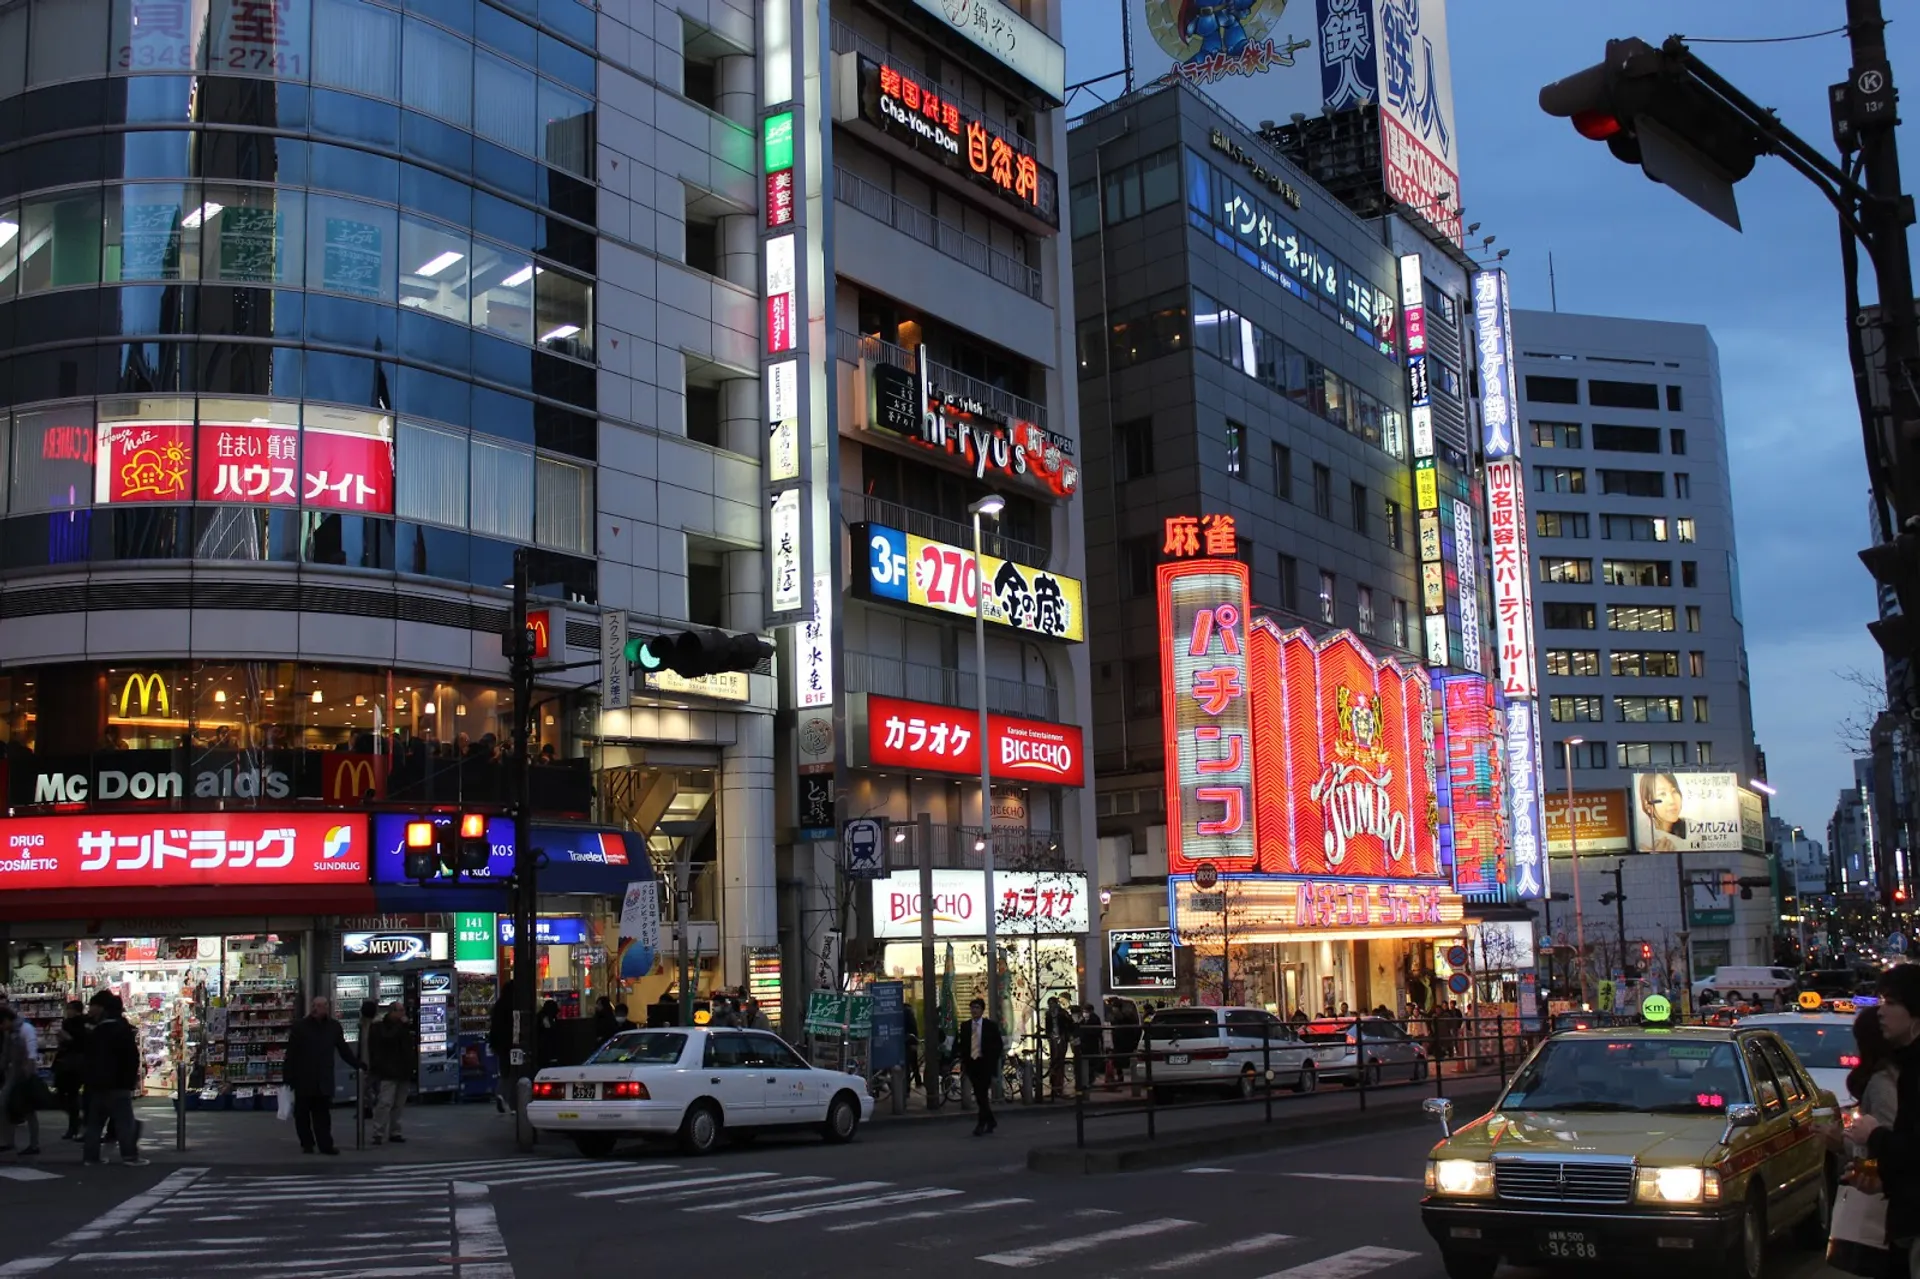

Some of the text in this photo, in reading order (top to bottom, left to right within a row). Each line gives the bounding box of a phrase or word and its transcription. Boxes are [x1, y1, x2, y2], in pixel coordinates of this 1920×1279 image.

[973, 2, 1016, 51] 鍋ぞう
[880, 64, 960, 135] 韓国料理
[880, 94, 959, 155] Cha-Yon-Don
[966, 120, 1039, 207] 自然洞
[776, 173, 792, 224] 美容室
[1225, 196, 1324, 285] インターネット
[1325, 265, 1336, 295] &
[1475, 272, 1510, 454] カラオケの鉄人
[99, 429, 132, 447] House
[123, 430, 158, 455] Mate
[217, 432, 296, 460] 住まい 賃貸
[1417, 459, 1432, 469] 4F
[213, 464, 376, 505] ハウスメイト
[1163, 514, 1236, 557] 麻雀
[871, 535, 906, 586] 3F
[1488, 464, 1524, 694] 100名収容大パーティールーム
[994, 560, 1065, 636] 金の蔵
[609, 615, 621, 705] スクランブル交差点
[805, 693, 826, 704] B1F
[885, 716, 971, 757] カラオケ
[1028, 730, 1064, 742] Entertainment
[1189, 604, 1244, 834] パチンコ
[1001, 736, 1072, 771] BIG ECHO
[1002, 806, 1024, 818] ECHO
[1507, 701, 1540, 897] カラオケの鉄人
[10, 835, 44, 846] DRUG
[1689, 821, 1738, 833] レオパレス21
[22, 849, 31, 859] &
[77, 828, 297, 871] サンドラッグ
[313, 862, 361, 871] SUNDRUG
[567, 850, 604, 863] Travelex
[931, 893, 972, 920] CHO
[1003, 888, 1075, 918] カラオケ
[1296, 880, 1442, 928] パチンコ ジャンボ
[465, 918, 482, 927] 141
[369, 940, 414, 953] MEVIUS
[1645, 1004, 1665, 1013] km
[1549, 1241, 1597, 1258] 96-88
